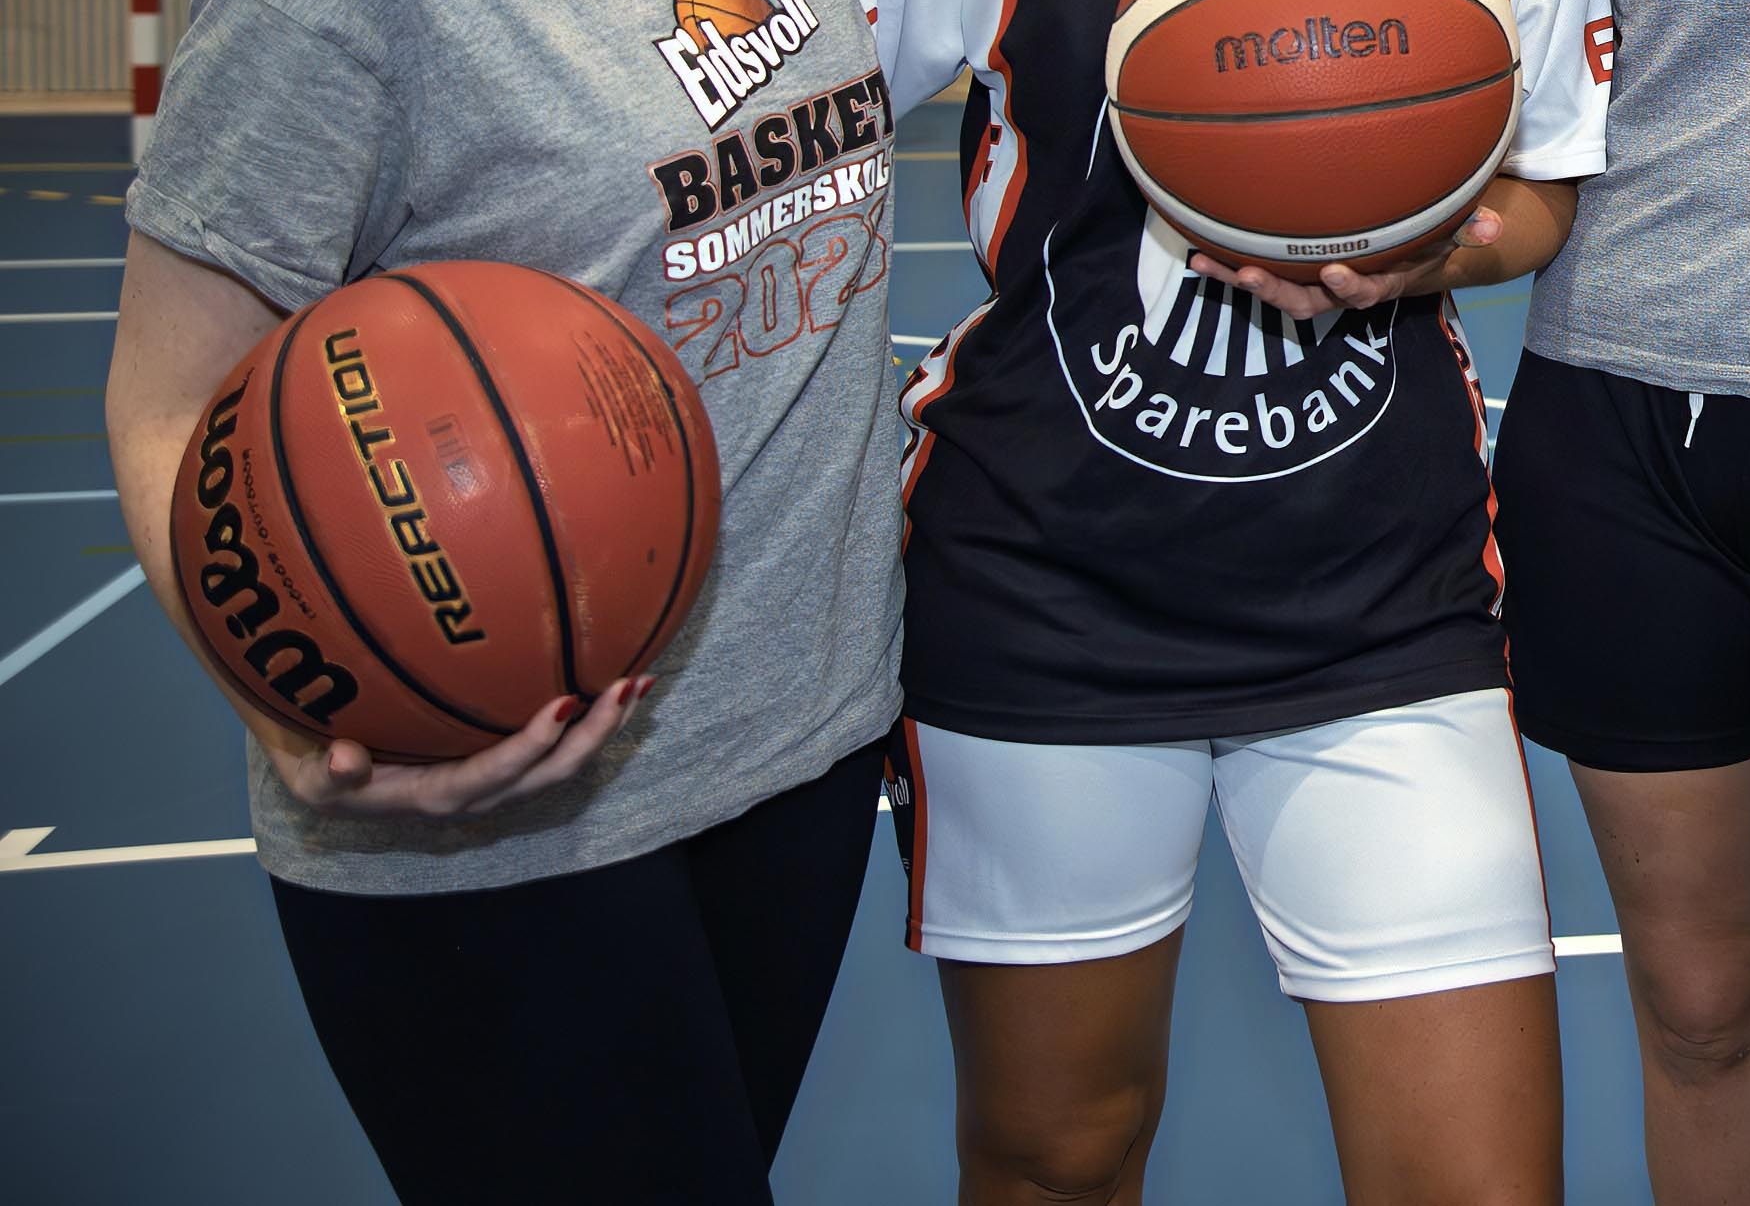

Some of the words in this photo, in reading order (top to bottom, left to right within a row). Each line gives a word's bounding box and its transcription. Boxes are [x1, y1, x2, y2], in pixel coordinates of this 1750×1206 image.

[1214, 15, 1410, 74] molten
[647, 65, 894, 234] BASKET
[663, 149, 891, 281] SOMMERSKOL
[1091, 322, 1388, 454] Sparebank
[198, 367, 359, 726] Wilson
